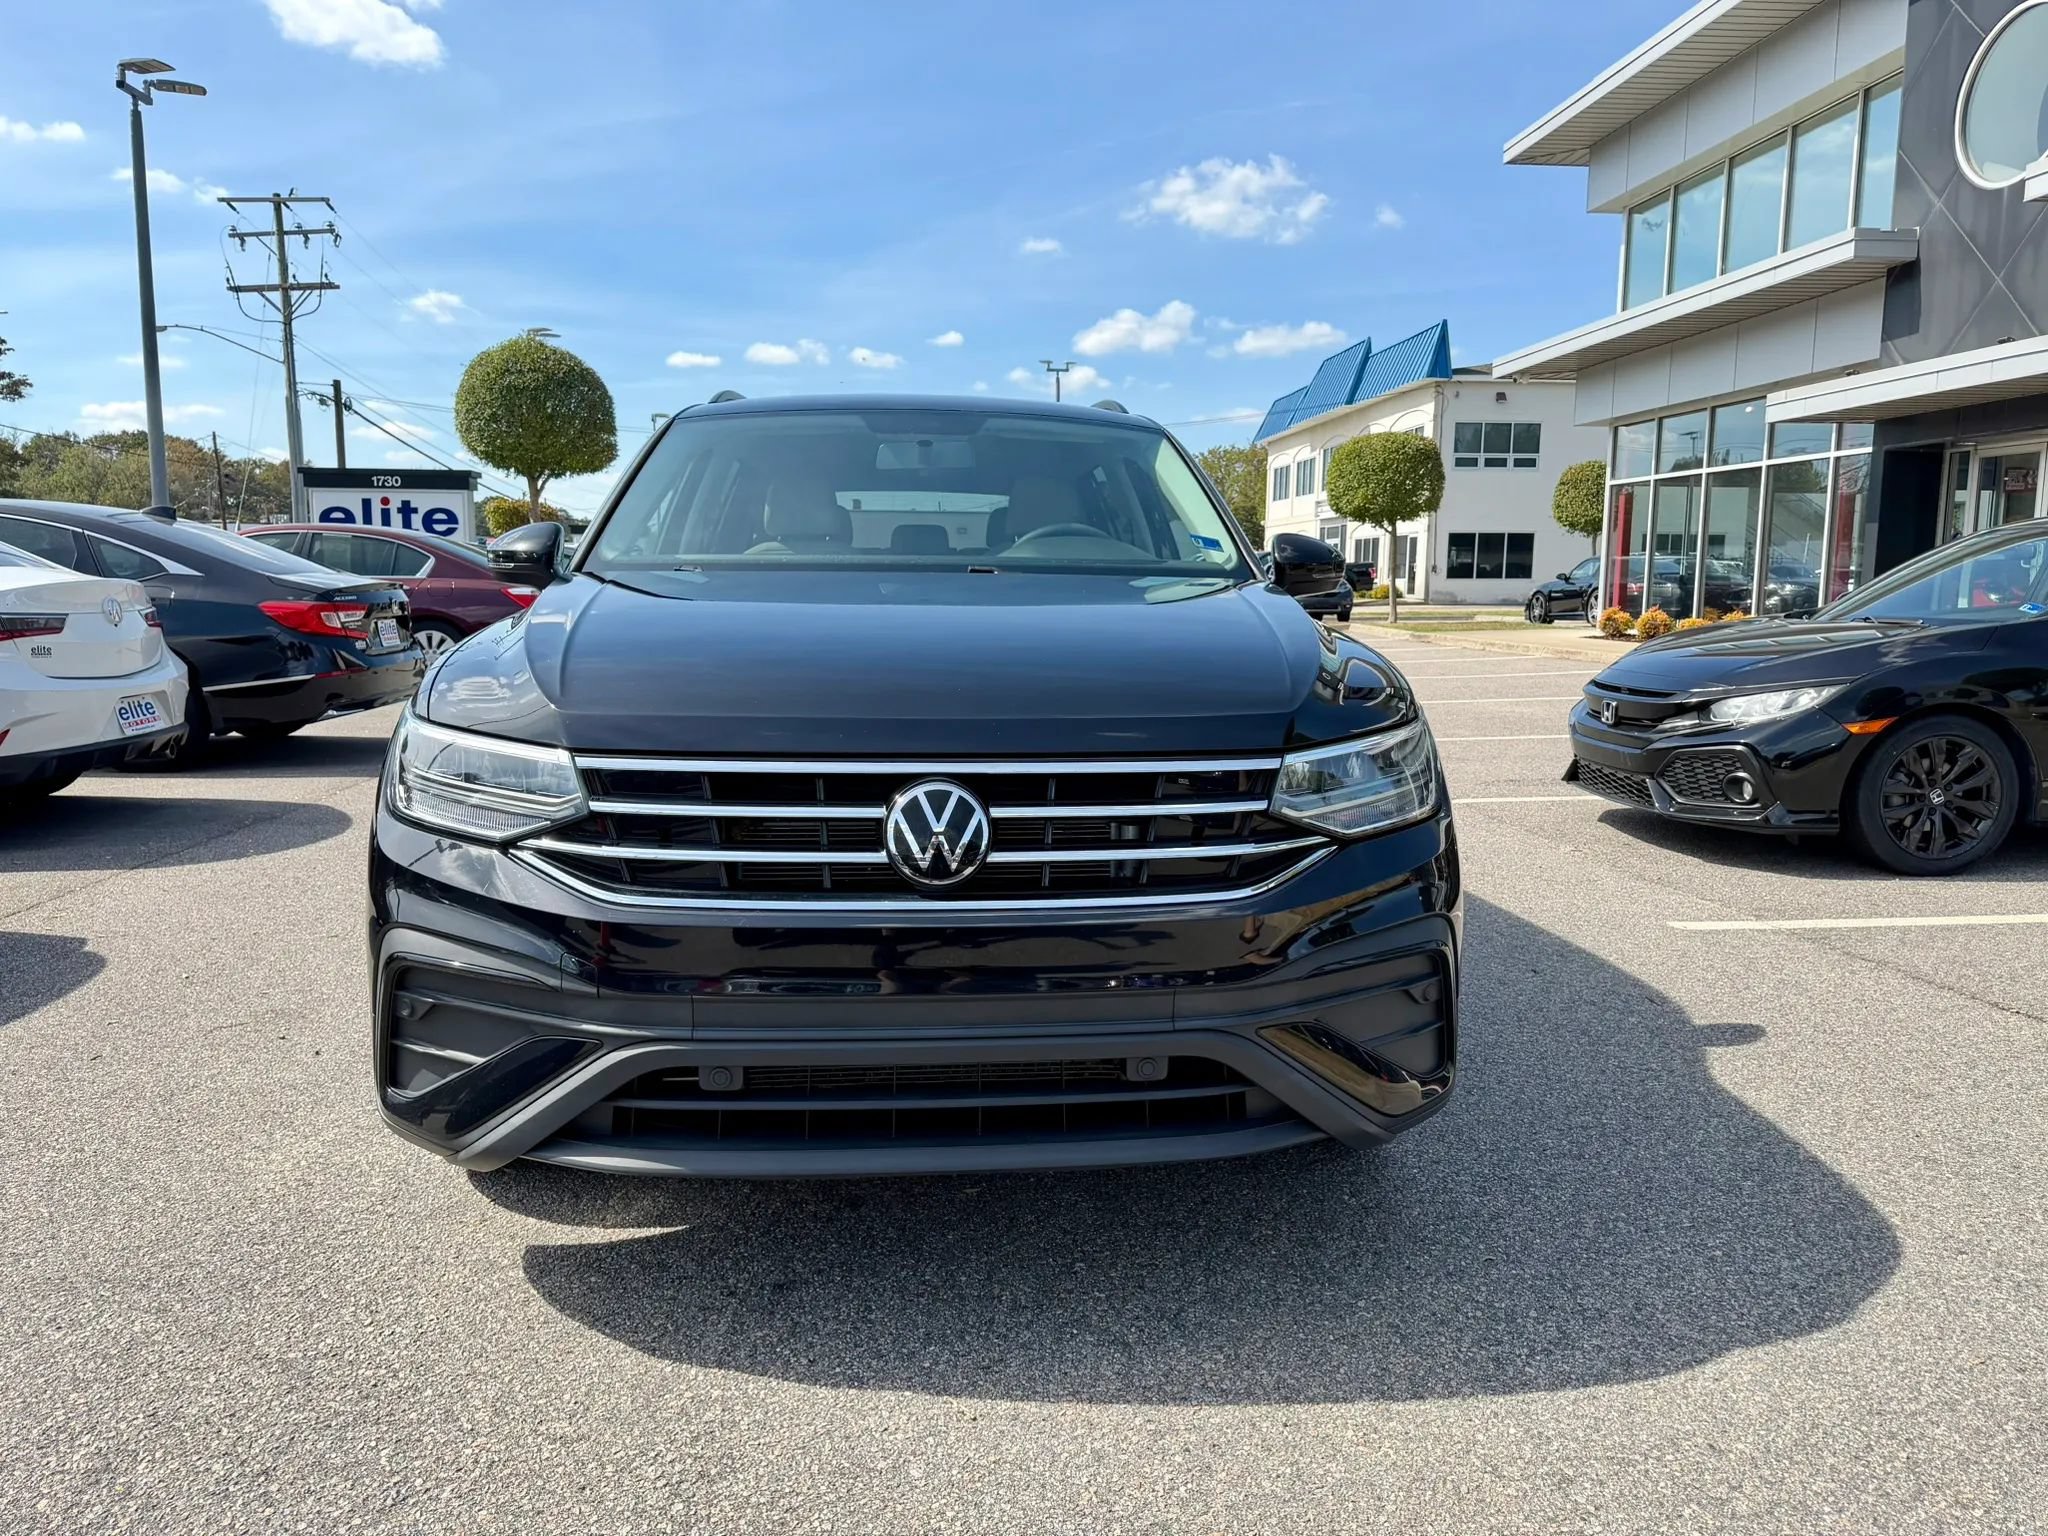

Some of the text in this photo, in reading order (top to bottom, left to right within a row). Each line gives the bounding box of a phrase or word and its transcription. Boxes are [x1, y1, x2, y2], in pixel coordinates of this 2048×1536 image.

[371, 476, 401, 487] 1730
[319, 496, 459, 537] elite
[380, 622, 397, 636] elite
[31, 645, 52, 654] elite
[118, 700, 156, 721] elite
[122, 715, 161, 729] MOTORS
